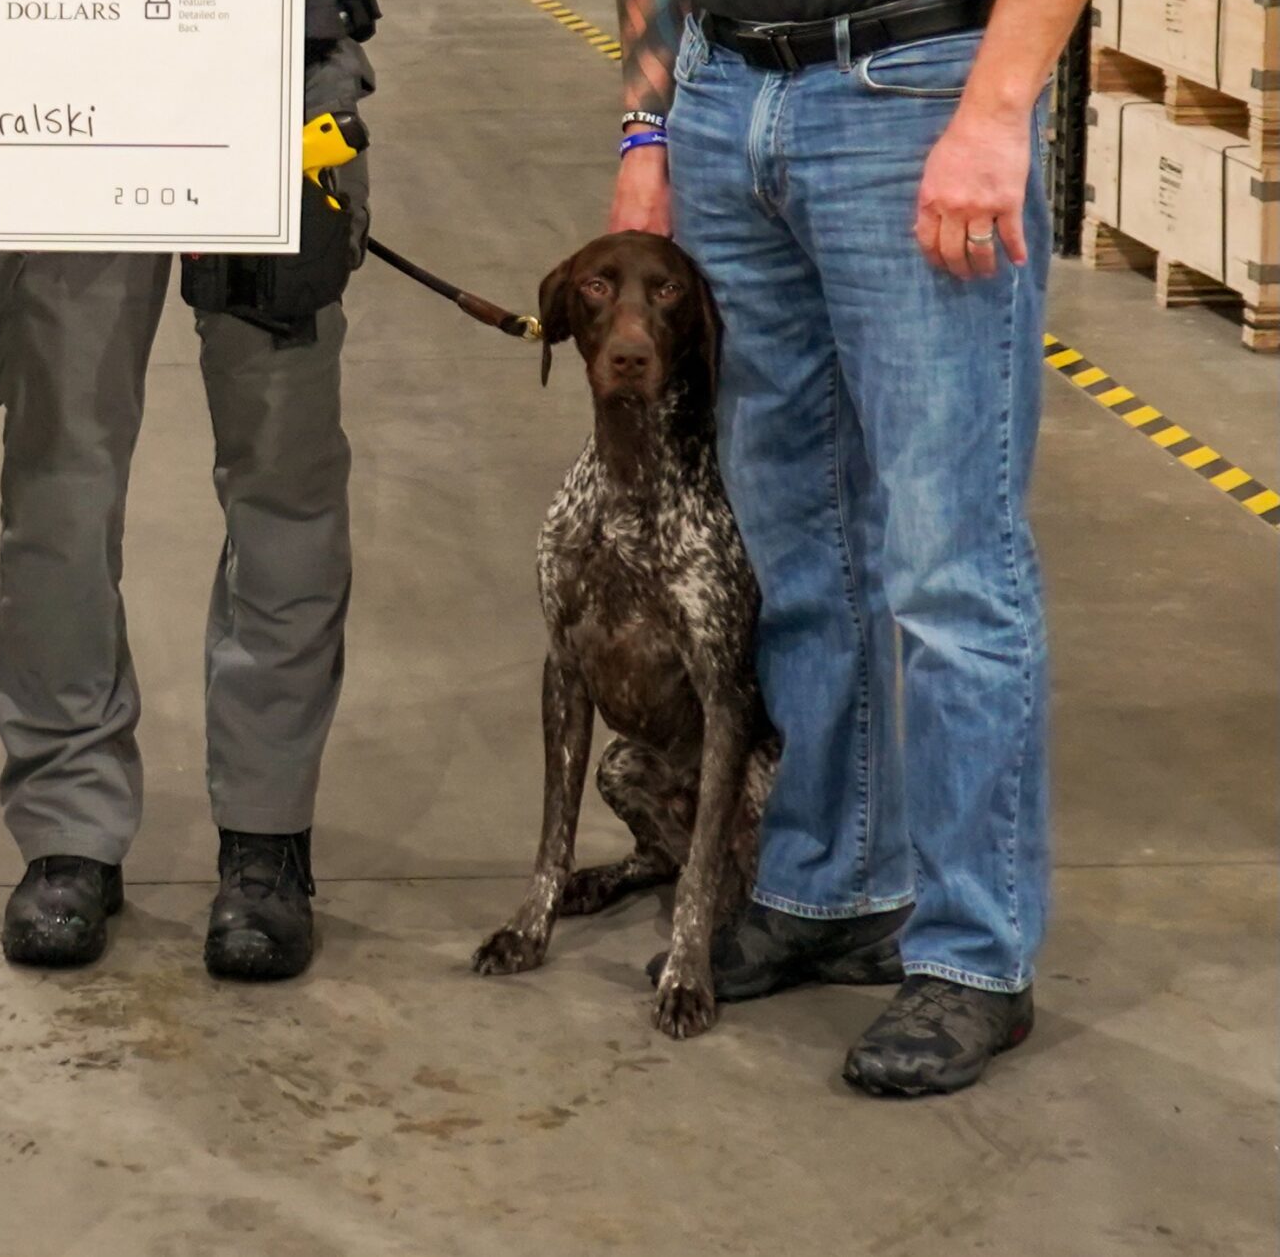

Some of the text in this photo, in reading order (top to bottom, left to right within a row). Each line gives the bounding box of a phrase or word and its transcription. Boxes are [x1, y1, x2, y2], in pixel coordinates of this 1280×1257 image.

[6, 0, 121, 21] DOLLARS
[178, 9, 230, 20] Detailed on
[637, 111, 664, 126] THE
[114, 187, 199, 206] 2004
